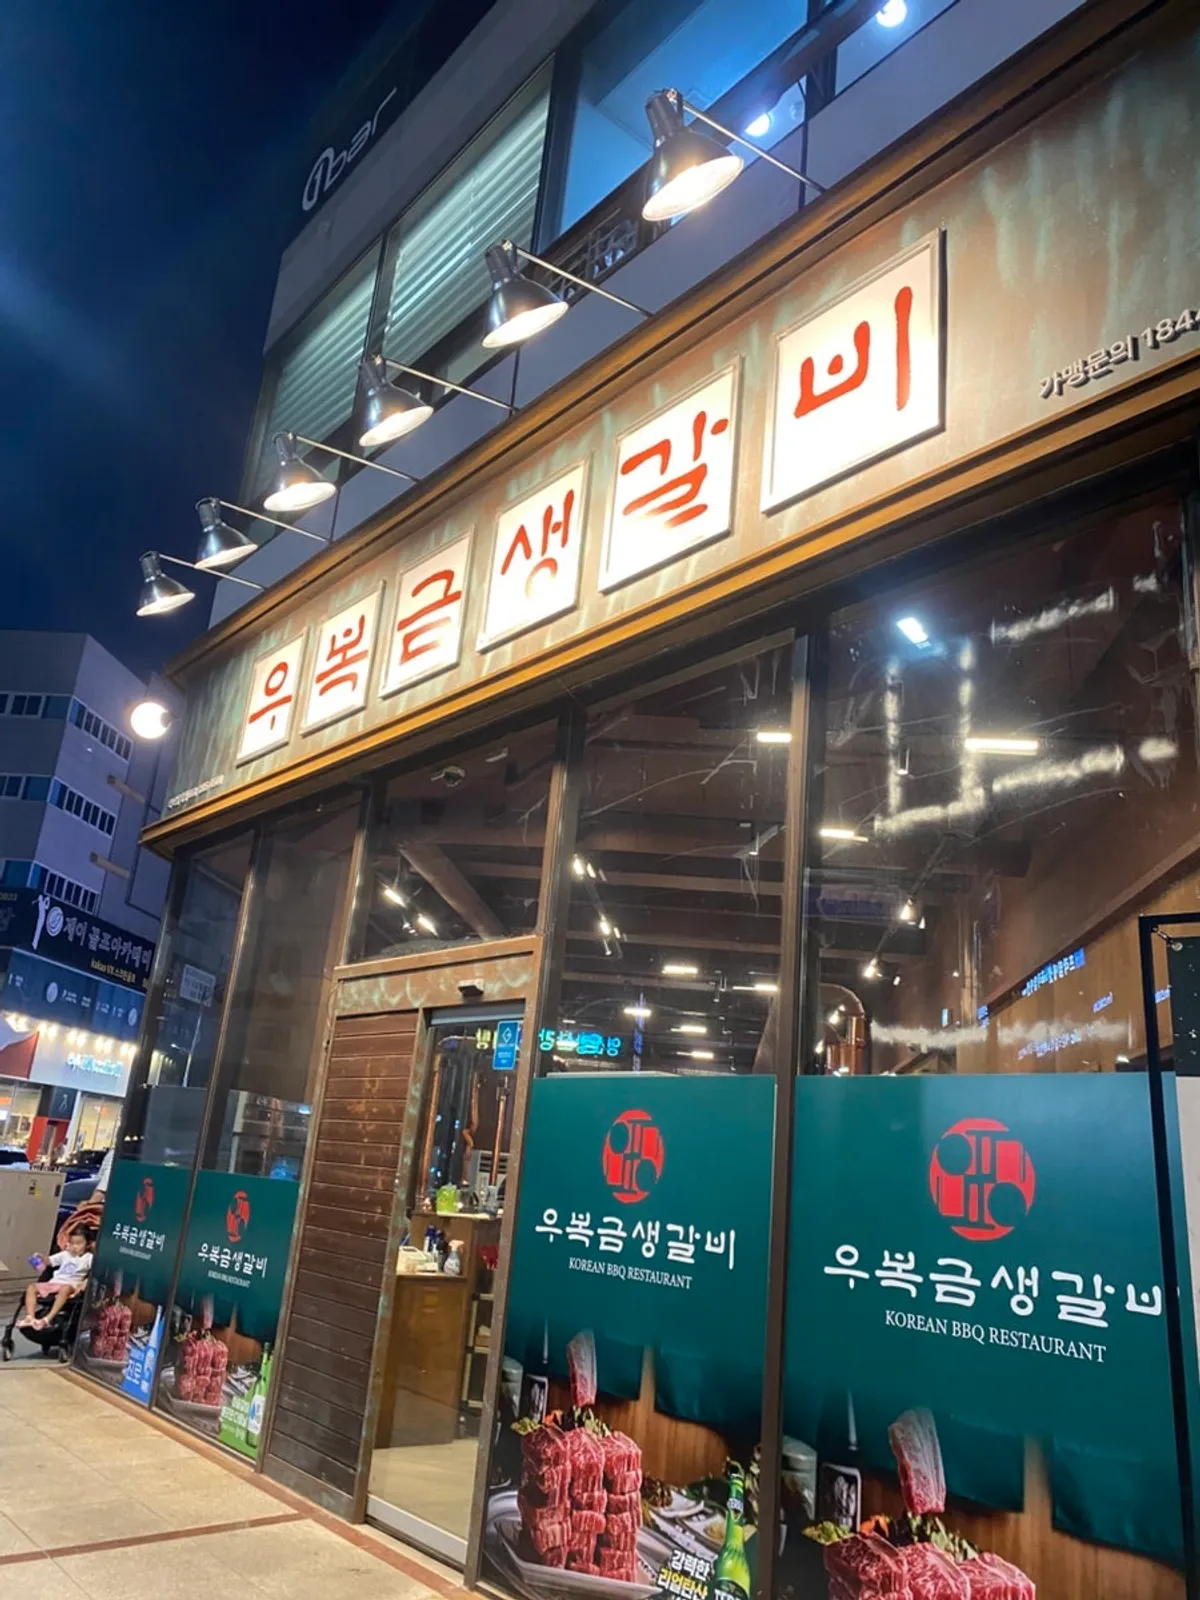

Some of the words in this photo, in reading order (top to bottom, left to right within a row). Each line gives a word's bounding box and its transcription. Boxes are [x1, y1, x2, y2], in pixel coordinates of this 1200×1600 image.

[1039, 334, 1135, 398] 가맹문의
[248, 285, 913, 733] 우복금생갈비
[112, 1222, 165, 1252] 우복금생갈비
[535, 1208, 736, 1270] 우복금생갈비
[198, 1242, 268, 1278] 우복금생갈비
[568, 1257, 606, 1274] KOREAN
[606, 1263, 627, 1281] BBQ
[627, 1266, 693, 1290] RESTAURANT
[885, 1309, 949, 1335] KOREAN
[951, 1320, 986, 1345] BBQ
[988, 1326, 1107, 1363] RESTAURANT
[657, 1567, 708, 1600] 리얼탄산
[671, 1549, 710, 1582] 강력한
